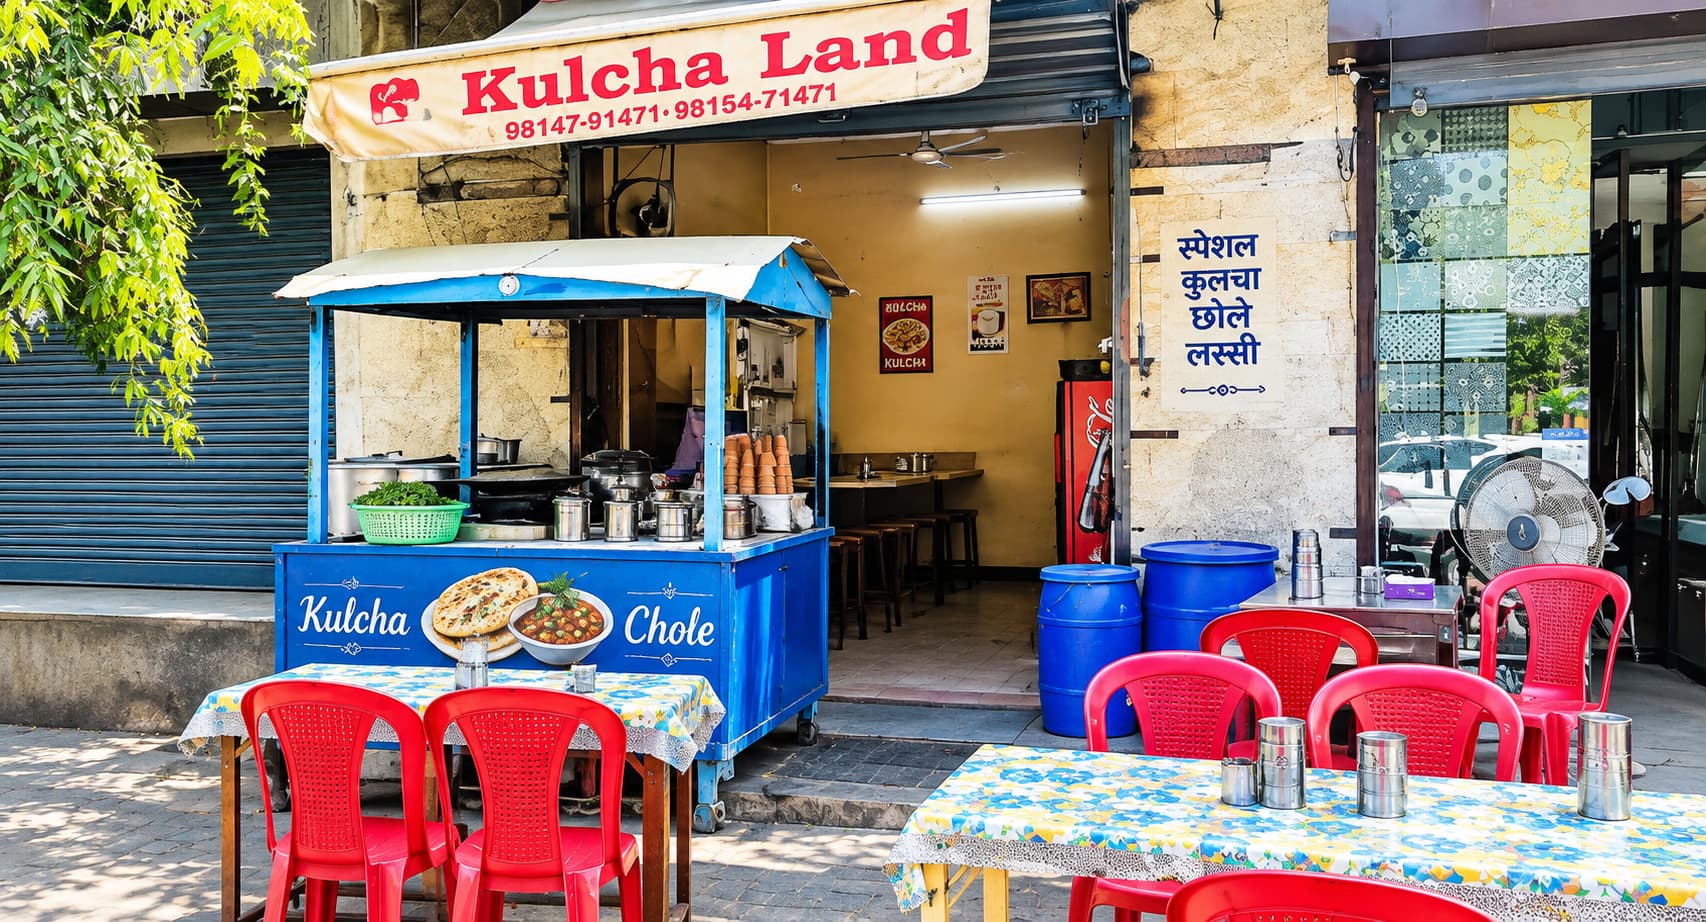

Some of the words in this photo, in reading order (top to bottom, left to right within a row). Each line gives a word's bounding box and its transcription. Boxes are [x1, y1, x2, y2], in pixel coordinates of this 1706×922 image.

[461, 46, 729, 116] Kulcha
[760, 7, 972, 79] Land
[505, 104, 660, 141] 98147-91471
[674, 82, 837, 120] 98154-71471
[1177, 229, 1259, 260] स्पेशल
[1181, 267, 1262, 300] कुलचा
[1188, 296, 1254, 330] छोले
[1185, 332, 1262, 366] लस्सी
[297, 595, 411, 636] Kulcha
[623, 604, 716, 647] Chole
